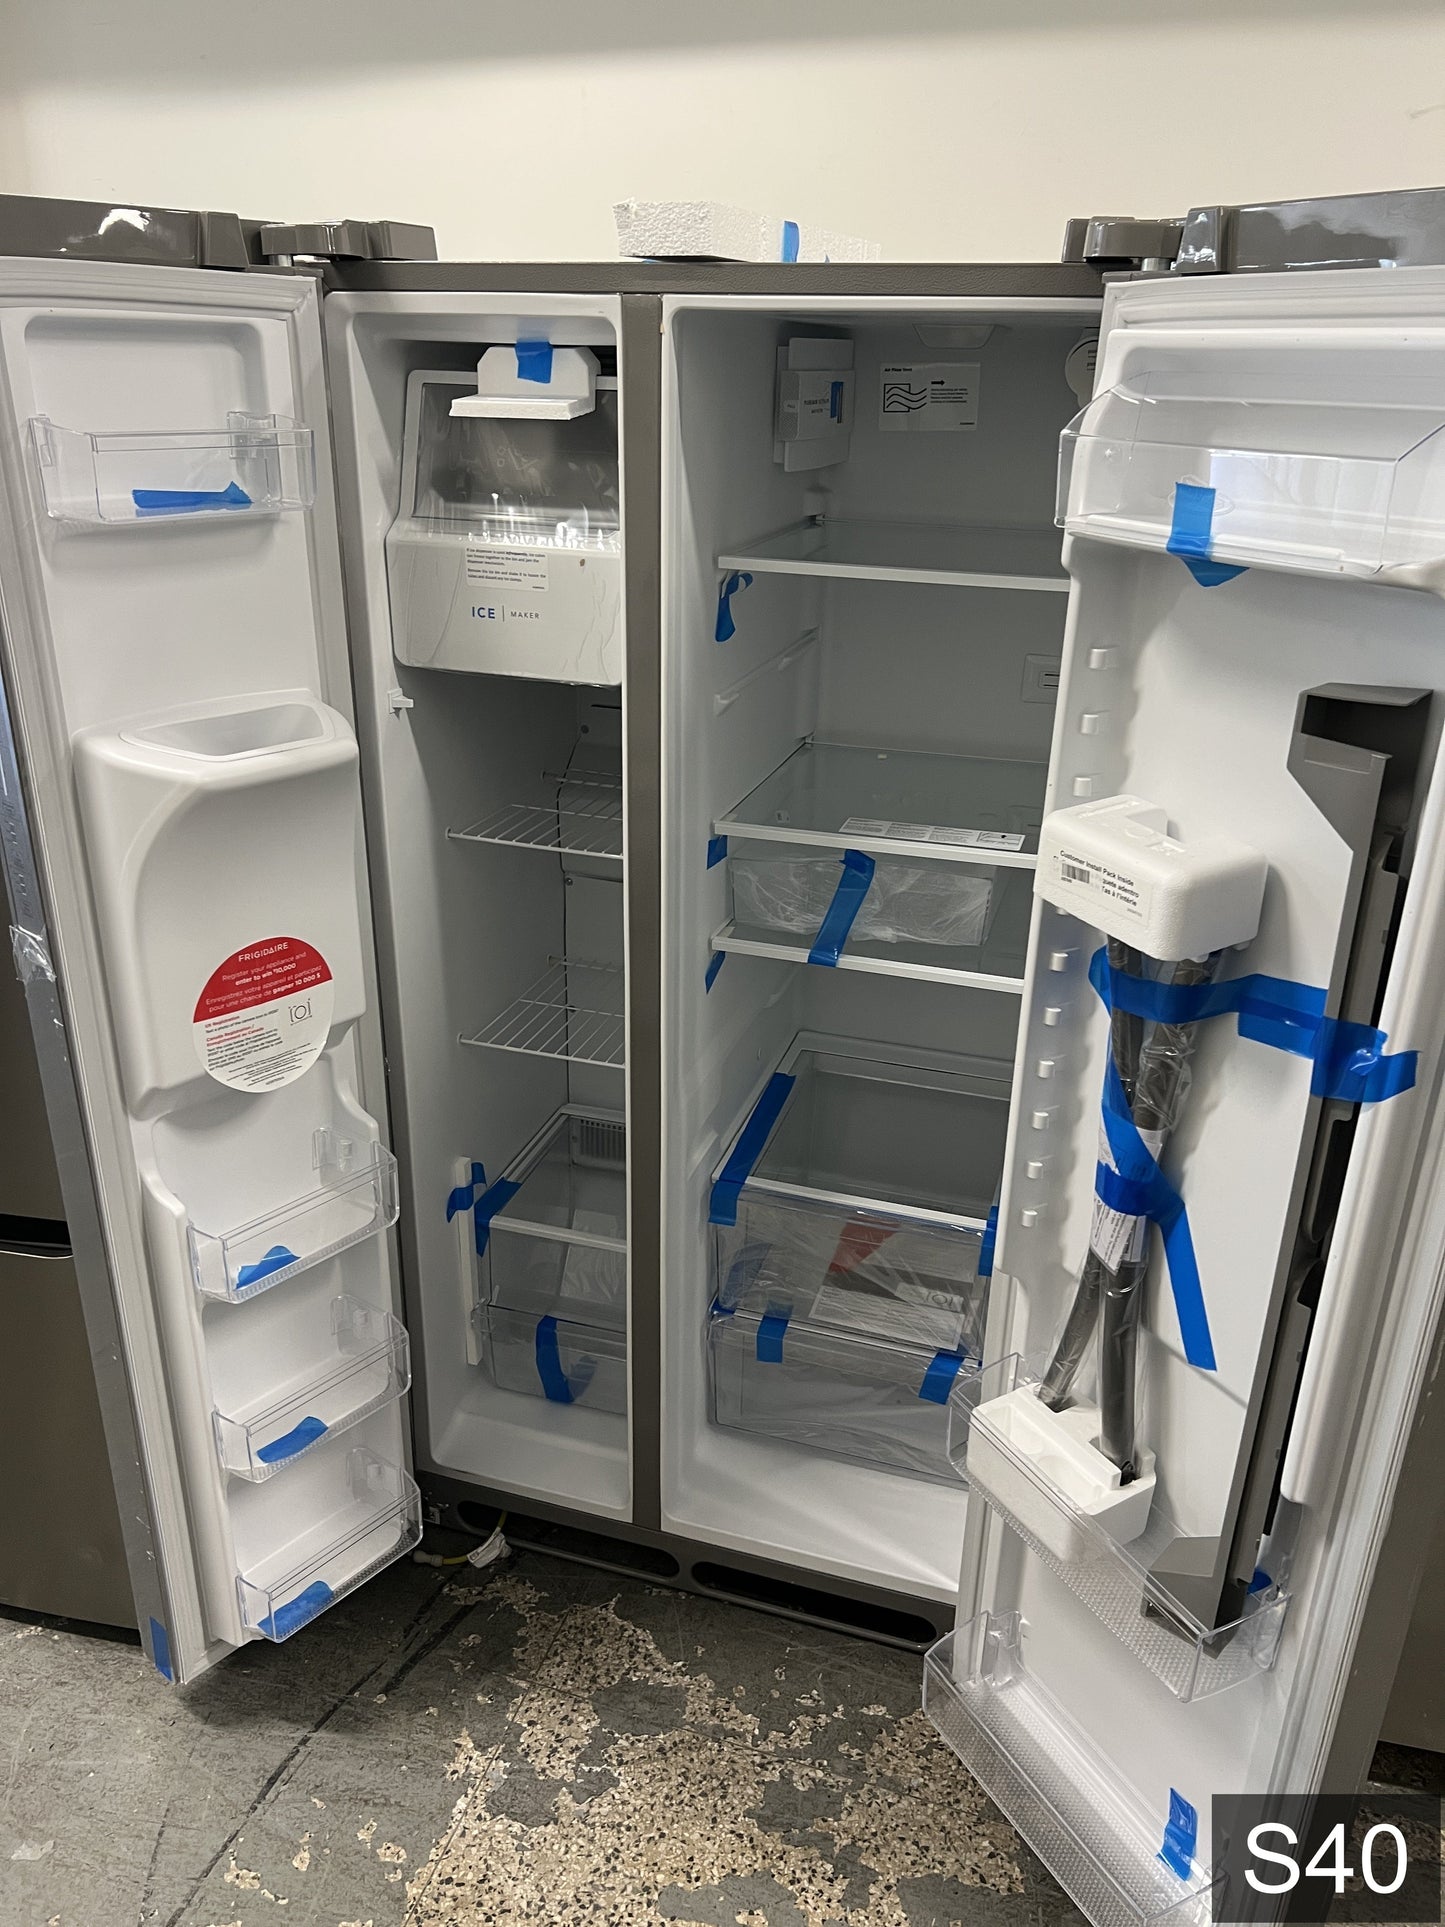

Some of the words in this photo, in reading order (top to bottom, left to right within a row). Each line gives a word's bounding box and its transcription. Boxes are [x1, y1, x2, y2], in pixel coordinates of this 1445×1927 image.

[472, 606, 495, 619] ICE
[510, 611, 540, 619] MAKER
[1060, 850, 1085, 864] Customer
[1086, 861, 1102, 872] Install
[1103, 868, 1116, 878] Pack
[1118, 874, 1134, 886] Inside
[238, 942, 289, 962] FRIGIDAIRE
[235, 976, 253, 986] enter
[262, 971, 273, 979] win
[272, 982, 295, 995] gagner
